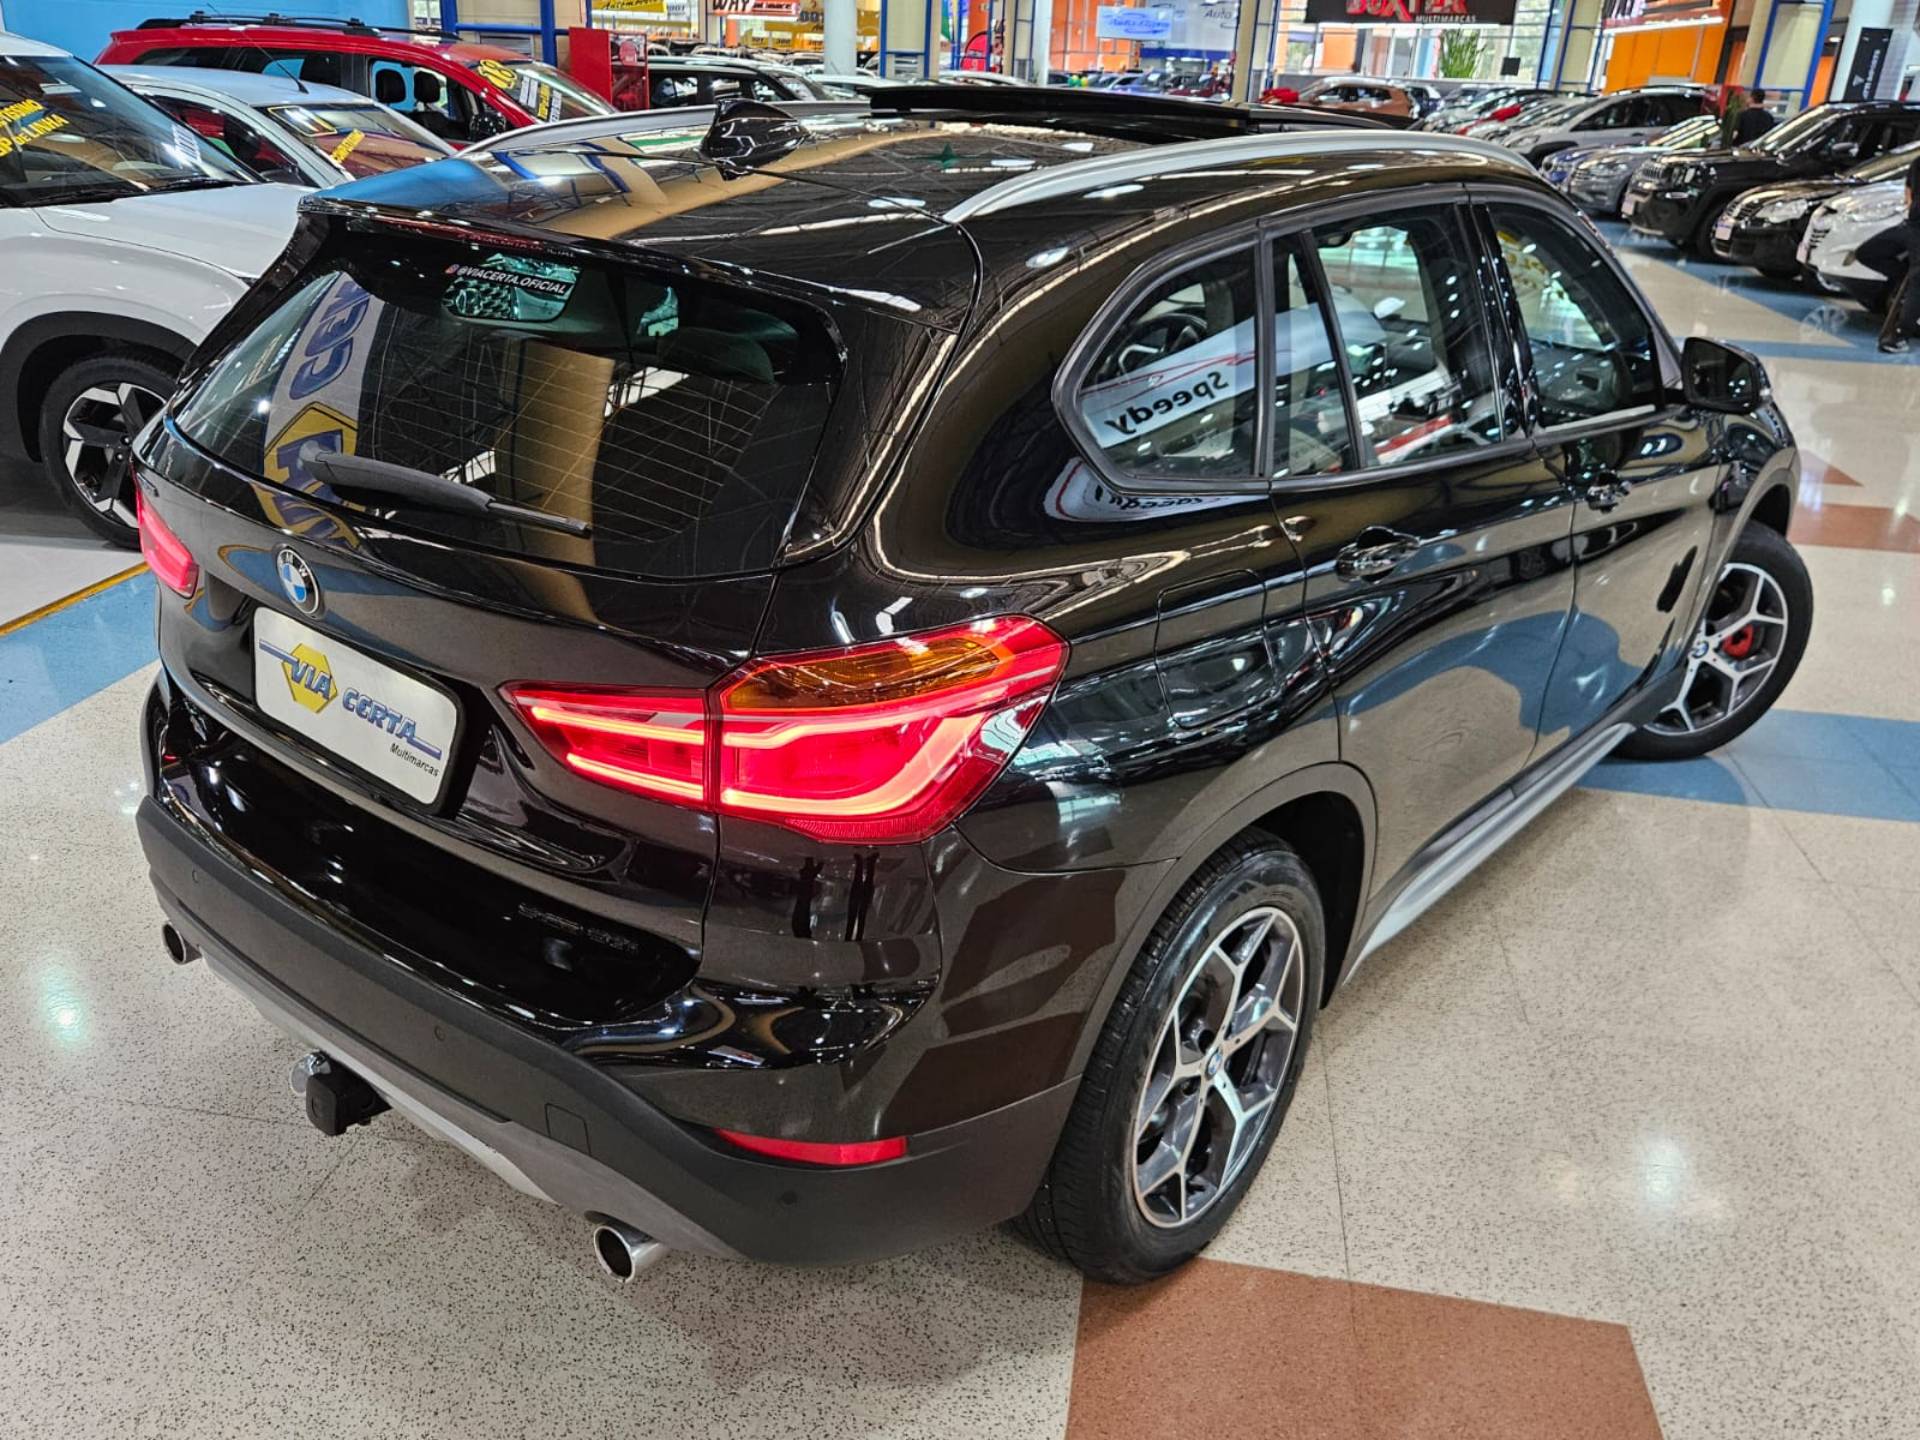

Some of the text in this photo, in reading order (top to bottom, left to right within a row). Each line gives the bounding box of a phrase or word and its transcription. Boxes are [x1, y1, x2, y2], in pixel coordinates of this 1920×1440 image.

[1415, 15, 1477, 24] MULTIMARCAS
[20, 113, 69, 138] LINHA
[456, 265, 568, 295] @VIACERTA.OFICIAL
[290, 661, 417, 739] VIA CERTA
[390, 743, 440, 777] Multimarcas
